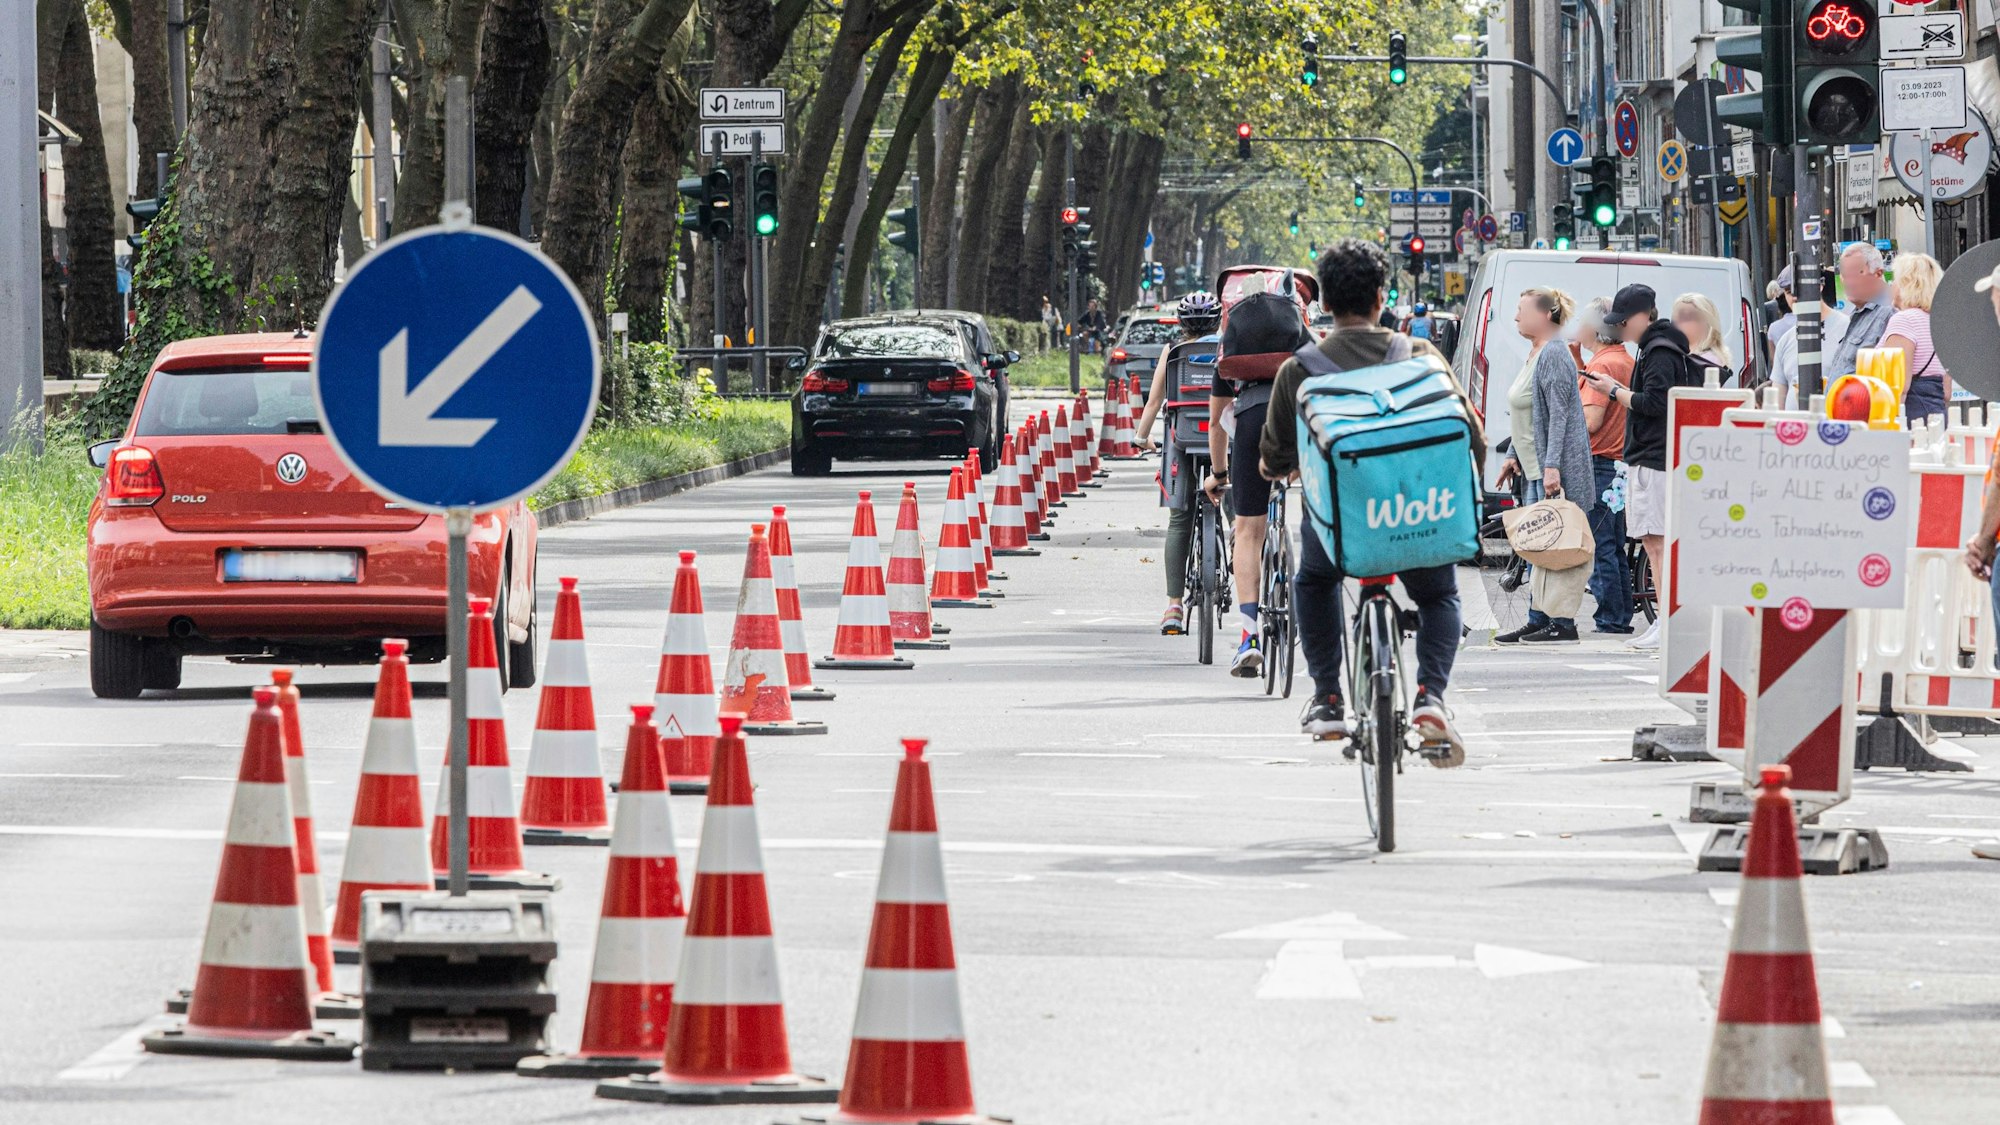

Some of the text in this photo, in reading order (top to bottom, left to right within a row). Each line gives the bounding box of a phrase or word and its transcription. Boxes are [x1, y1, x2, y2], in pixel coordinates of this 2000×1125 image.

[1901, 82, 1942, 90] 03.09.2023
[733, 98, 775, 110] Zentrum
[733, 133, 766, 145] Polii
[1930, 176, 1964, 186] ostüme
[1687, 431, 1891, 483] Gute Fahrradwege
[1750, 480, 1768, 502] für
[1782, 478, 1825, 501] ALLE
[172, 495, 207, 503] POLO
[1366, 487, 1456, 529] Wolt
[1770, 514, 1864, 539] Fahrradfahren
[1390, 527, 1438, 542] PARTNER
[1711, 561, 1762, 576] sicheres
[1769, 557, 1845, 581] Autofahren
